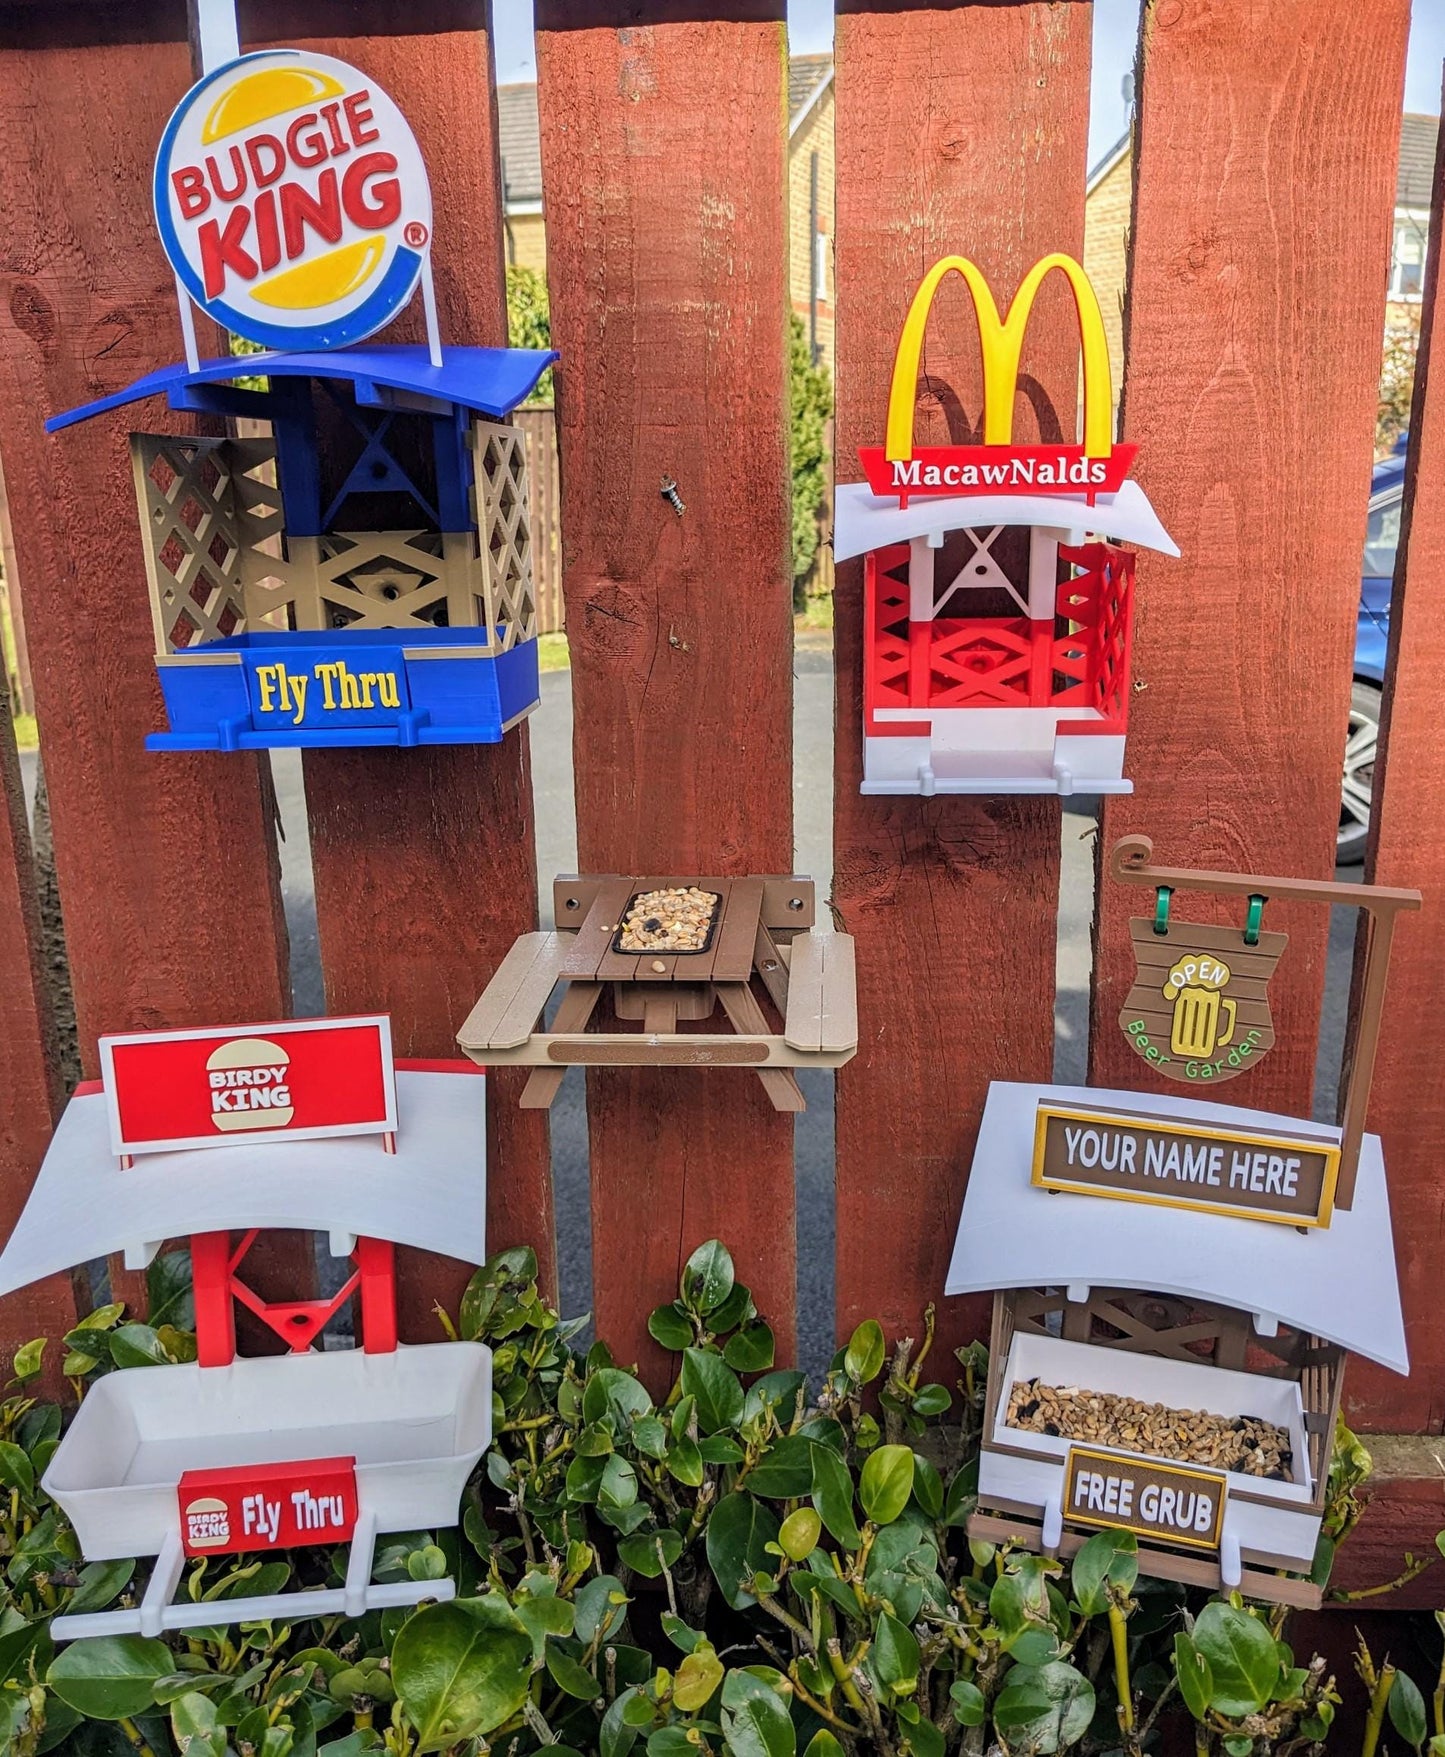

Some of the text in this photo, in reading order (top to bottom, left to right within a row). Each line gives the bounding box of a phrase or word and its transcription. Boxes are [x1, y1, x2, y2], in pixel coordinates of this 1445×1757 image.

[171, 89, 380, 220] BUDGIE
[198, 151, 402, 299] KING
[891, 456, 1107, 487] MacawNalds
[255, 661, 400, 725] Fly Thru
[1170, 961, 1227, 988] OPEN
[1128, 1020, 1262, 1079] Beer Garden
[208, 1066, 288, 1089] BIRDY
[211, 1085, 292, 1113] KING
[1064, 1126, 1301, 1198] YOUR NAME HERE
[187, 1511, 228, 1525] BIRDY
[242, 1489, 344, 1543] Fly Thru
[1074, 1470, 1213, 1532] FREE GRUB
[189, 1523, 230, 1538] KING
